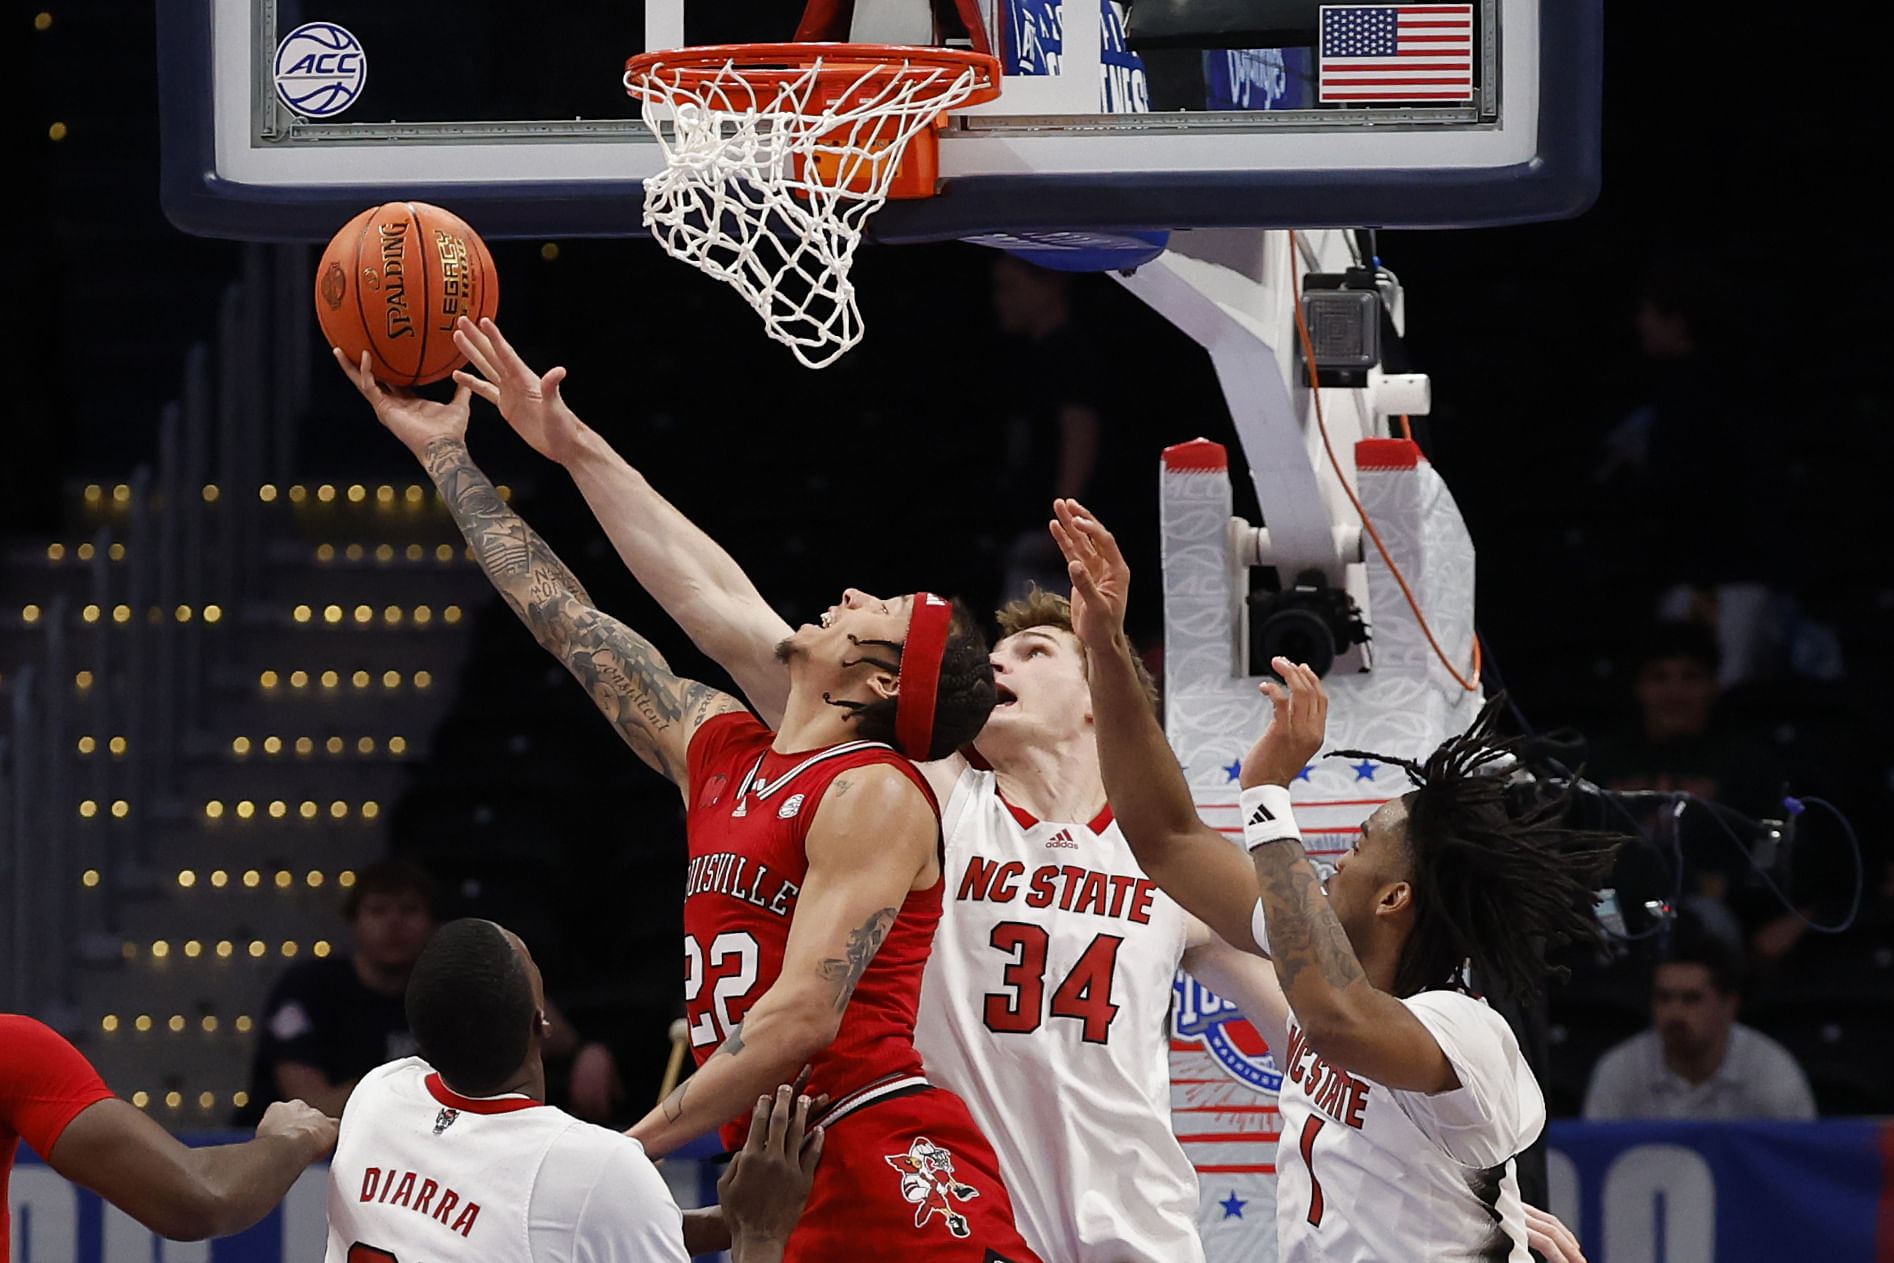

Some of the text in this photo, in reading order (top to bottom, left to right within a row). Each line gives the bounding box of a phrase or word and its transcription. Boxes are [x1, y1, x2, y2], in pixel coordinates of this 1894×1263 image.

[285, 53, 361, 75] ACC
[378, 222, 414, 339] SPALDING
[434, 229, 460, 332] LEGACY
[1045, 840, 1079, 849] adidas
[957, 856, 1159, 925] NC STATE
[983, 920, 1125, 1045] 34
[1304, 1055, 1371, 1130] STATE
[360, 1167, 481, 1238] DIARRA
[1299, 1113, 1326, 1228] 1
